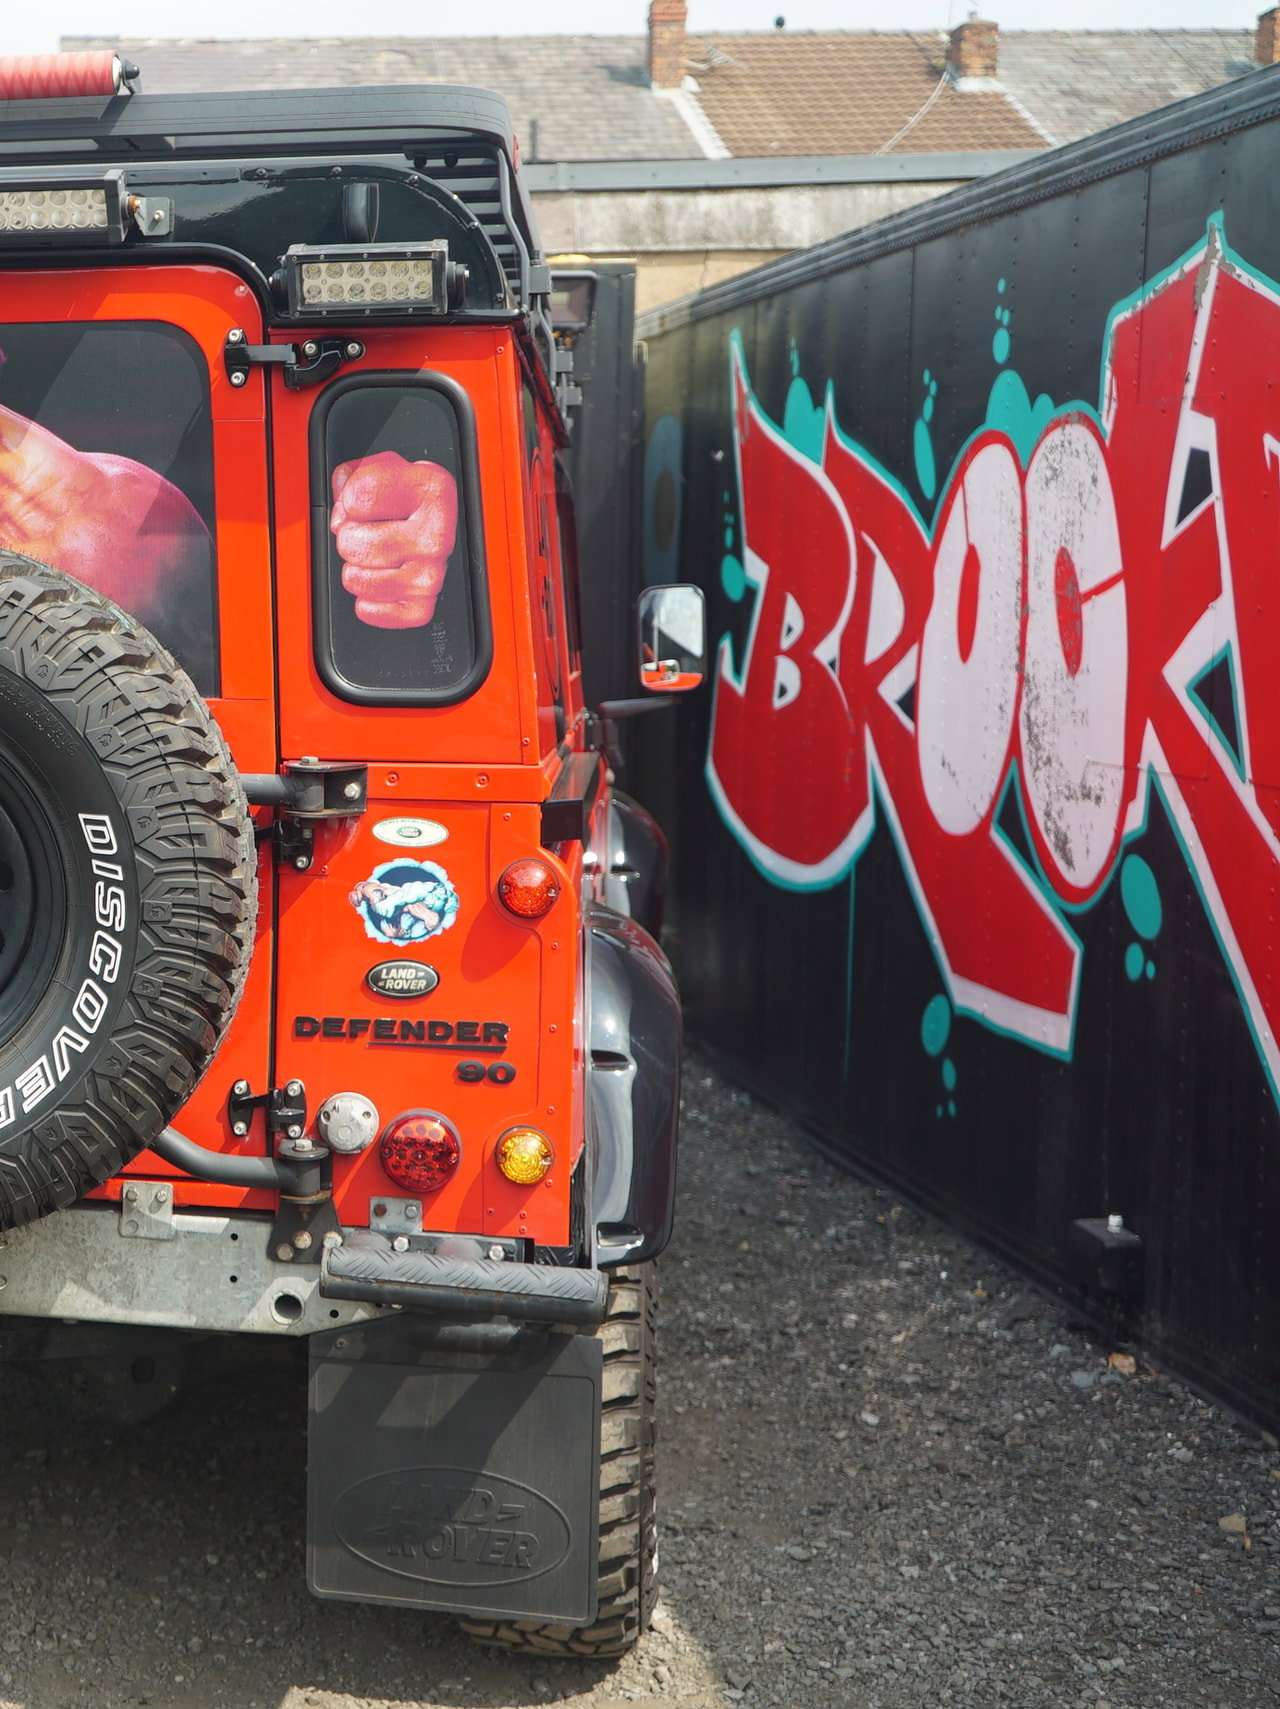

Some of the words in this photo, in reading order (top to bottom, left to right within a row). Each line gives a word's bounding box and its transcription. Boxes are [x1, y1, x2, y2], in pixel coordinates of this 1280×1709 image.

[706, 211, 1280, 1106] BROCK
[385, 979, 427, 990] ROVER
[294, 1015, 510, 1044] DEFENDER
[456, 1059, 517, 1085] 90
